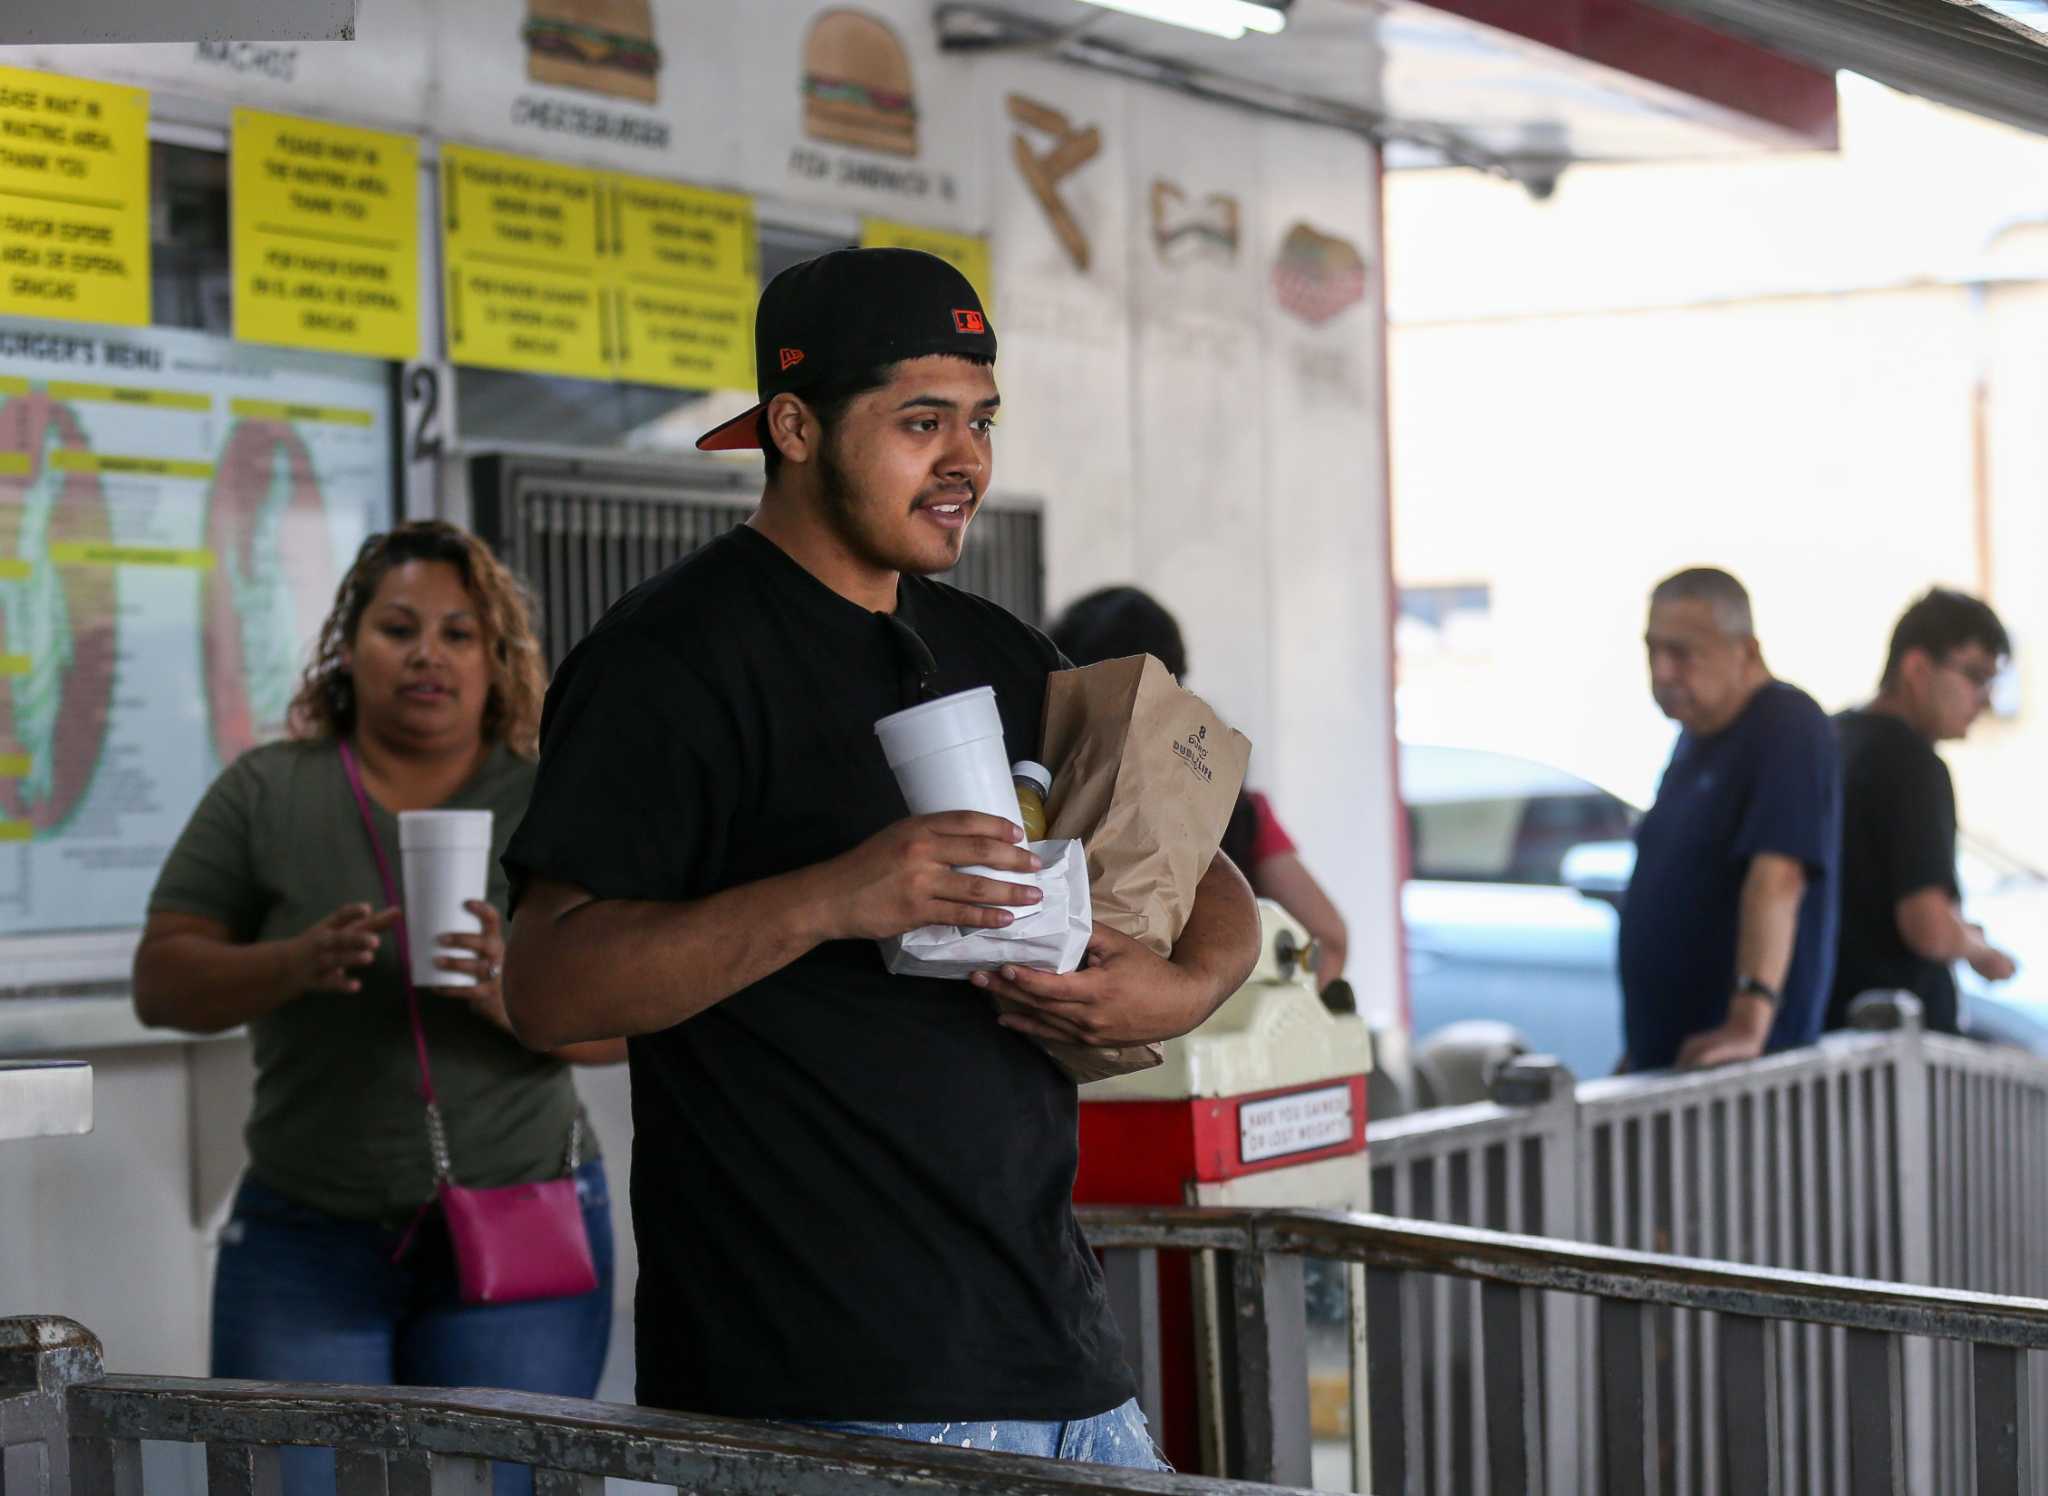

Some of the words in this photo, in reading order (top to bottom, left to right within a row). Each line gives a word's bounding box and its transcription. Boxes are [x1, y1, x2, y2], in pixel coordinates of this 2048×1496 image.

[411, 366, 443, 462] 2
[1199, 725, 1206, 739] 8
[1248, 1110, 1275, 1127] HAVE
[1278, 1105, 1301, 1123] YOU
[1268, 1127, 1296, 1148] LOST
